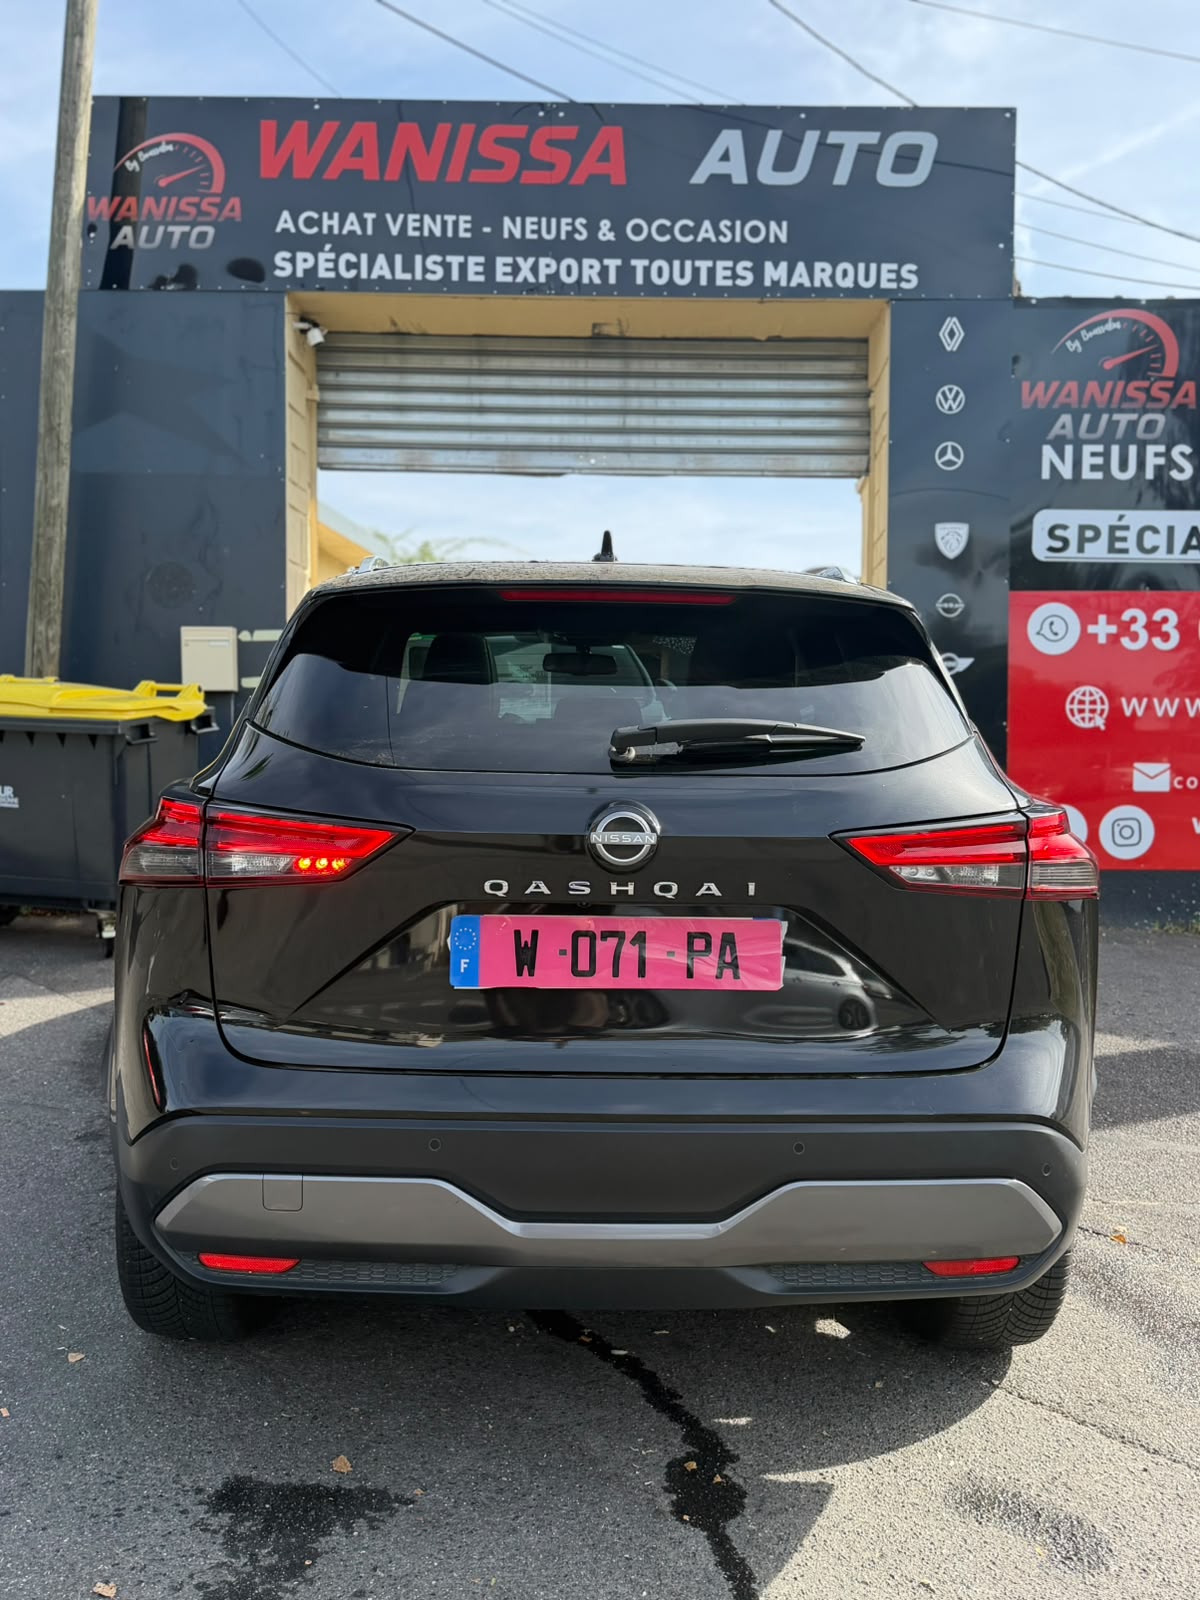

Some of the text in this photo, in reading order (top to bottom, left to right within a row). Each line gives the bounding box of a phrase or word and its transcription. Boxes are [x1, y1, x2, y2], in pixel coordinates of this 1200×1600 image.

[259, 119, 939, 188] WANISSA AUTO
[86, 196, 242, 221] WANISSA
[110, 225, 215, 250] AUTO
[275, 209, 376, 235] ACHAT
[385, 212, 472, 238] VENTE
[502, 215, 588, 241] NEUFS
[597, 217, 616, 241] &
[625, 218, 789, 243] OCCASION
[273, 245, 919, 290] SPÉCIALISTE EXPORT TOUTES MARQUES
[1021, 380, 1197, 409] WANISSA
[1046, 413, 1167, 440] AUTO
[1041, 443, 1194, 482] NEUFS
[1087, 607, 1181, 651] +33
[591, 833, 657, 844] NISSAN
[483, 879, 756, 898] QASHQAI
[460, 958, 470, 973] F
